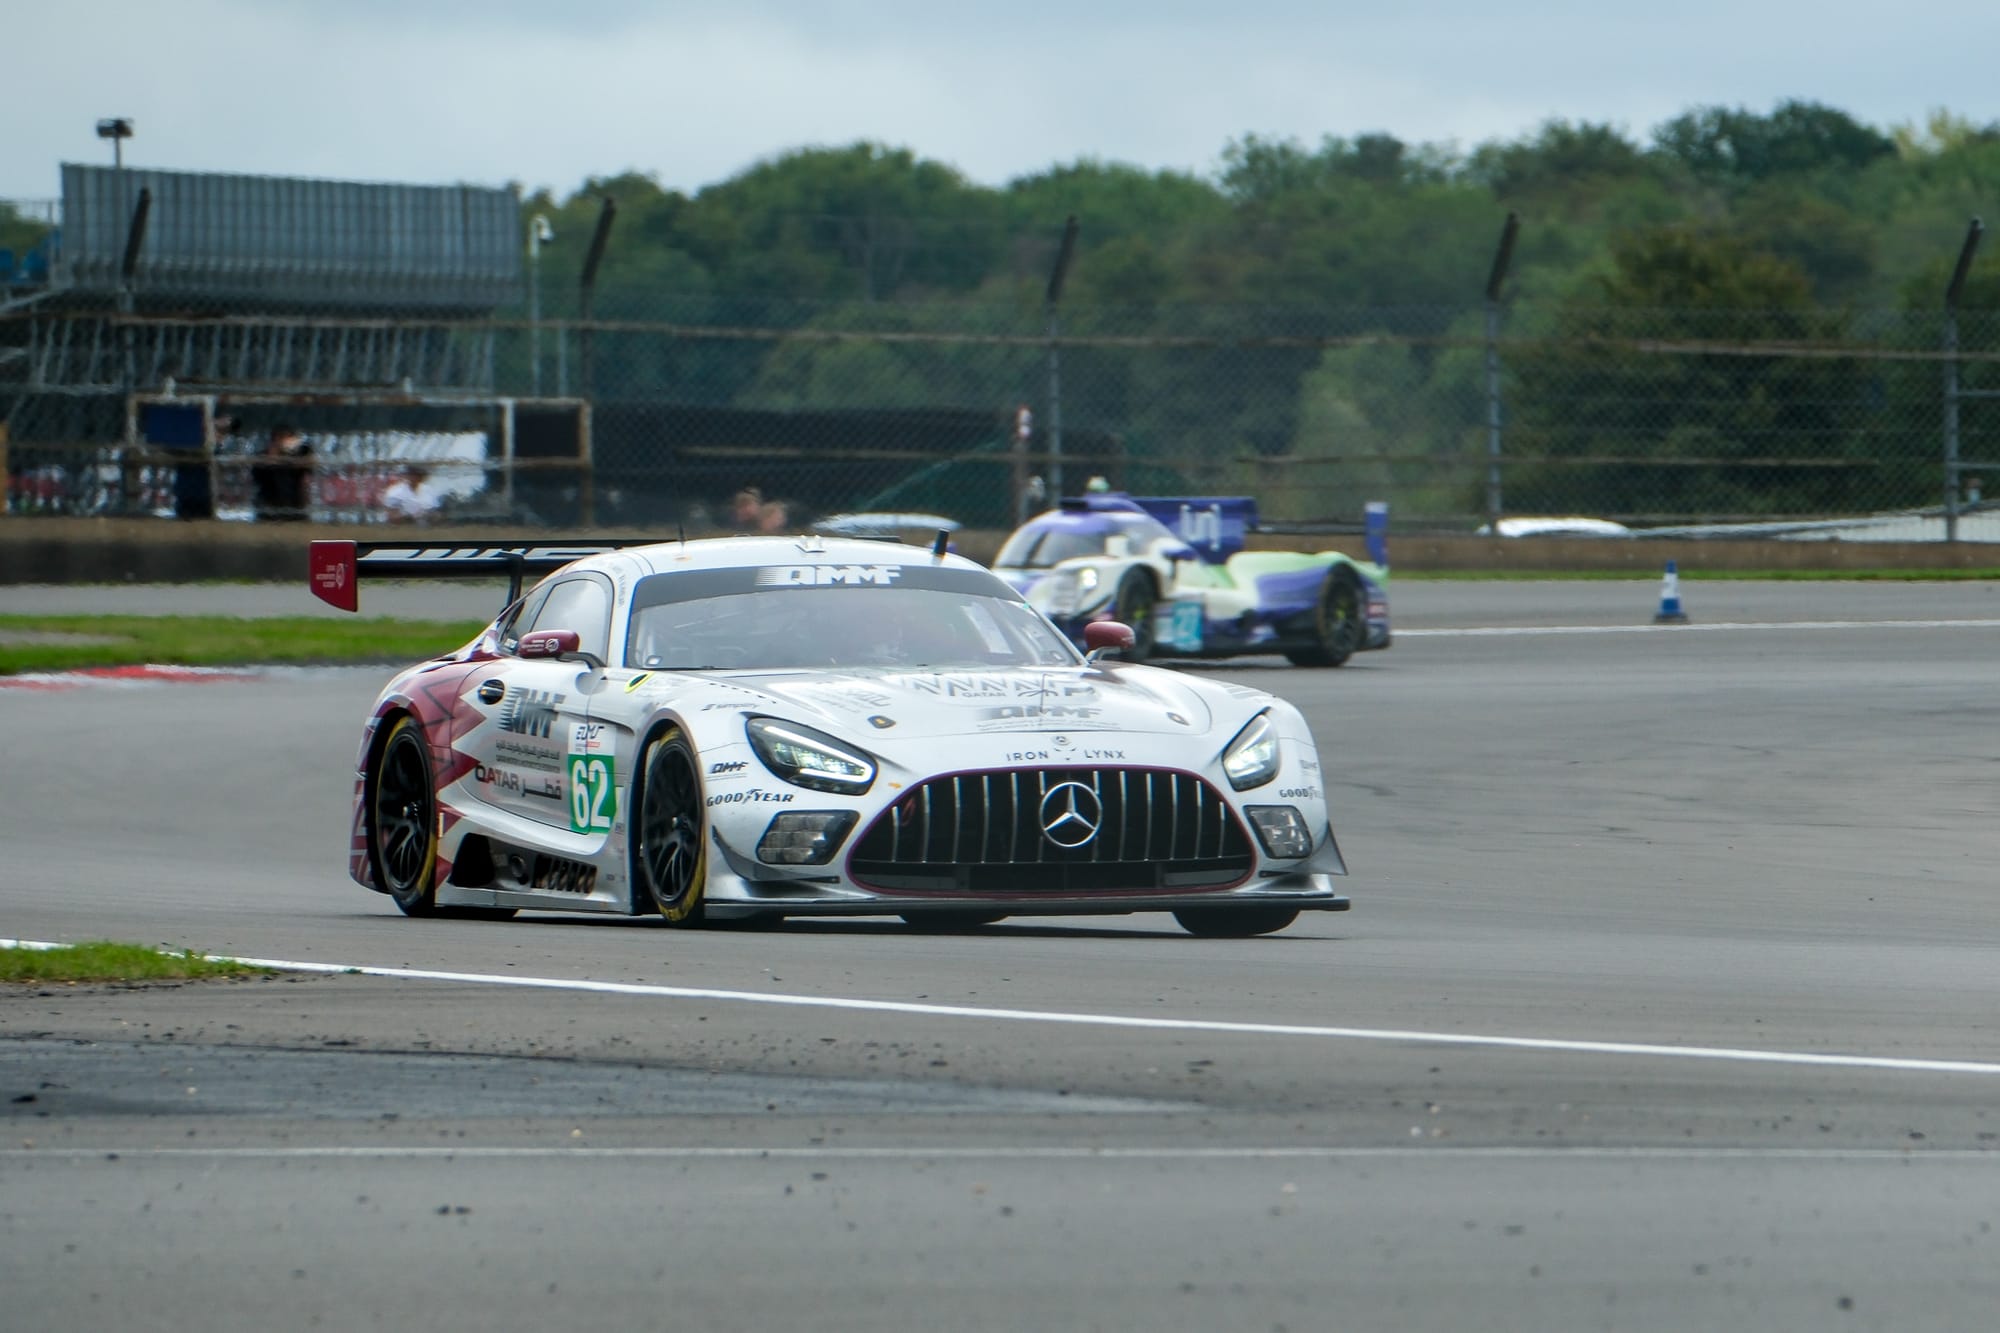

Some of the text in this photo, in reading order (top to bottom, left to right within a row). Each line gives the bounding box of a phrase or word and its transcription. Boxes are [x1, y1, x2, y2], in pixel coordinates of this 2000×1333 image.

[754, 565, 901, 586] QMMF
[1007, 750, 1126, 761] IRON LYNX
[475, 765, 519, 792] QATAR
[572, 759, 610, 828] 62
